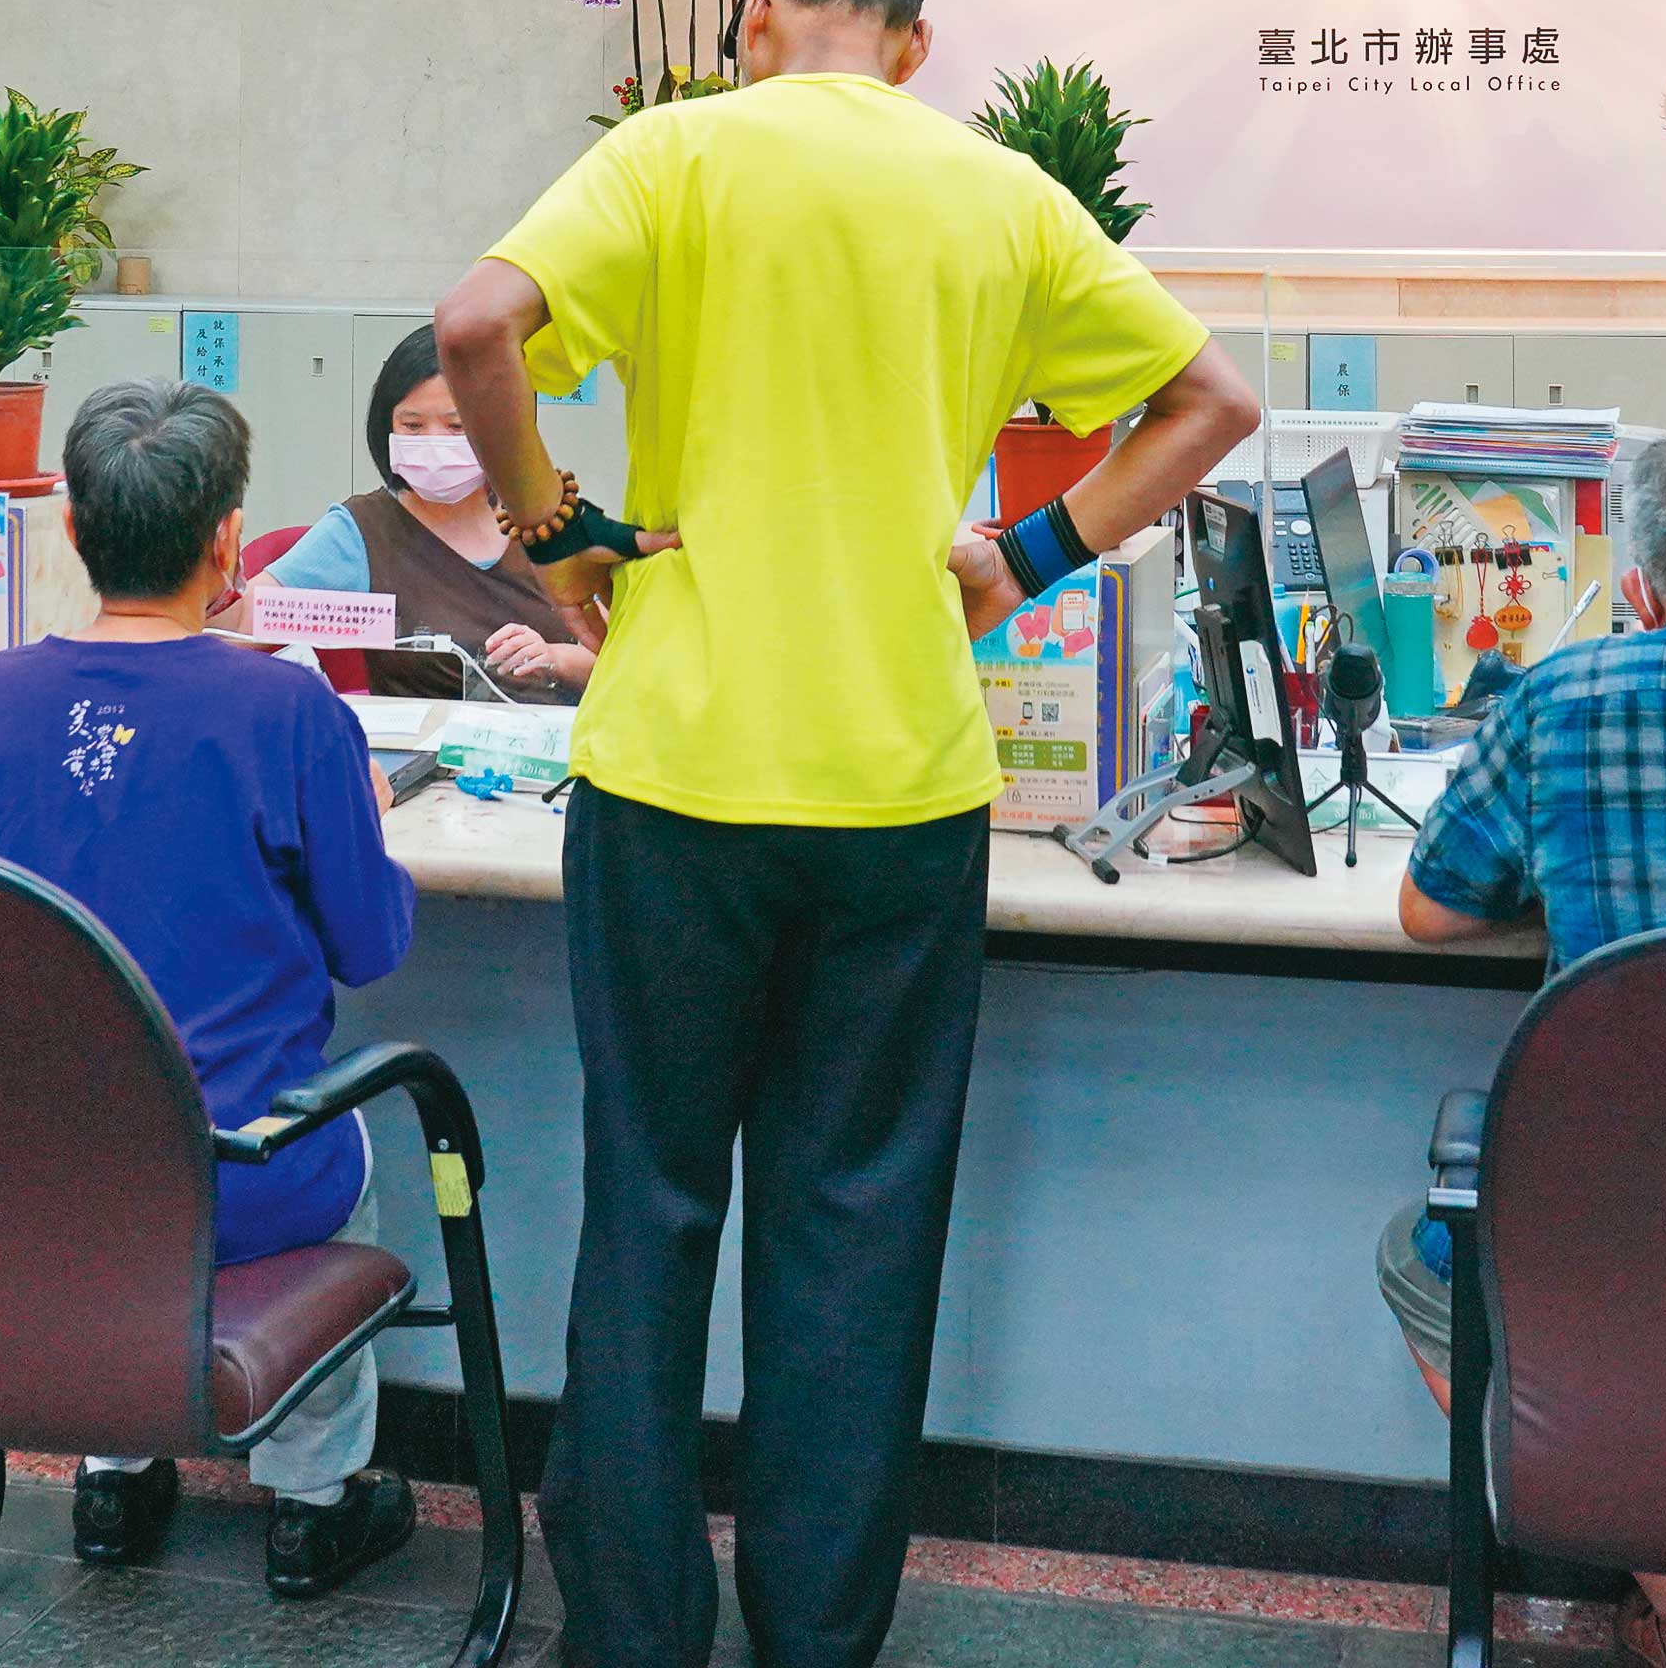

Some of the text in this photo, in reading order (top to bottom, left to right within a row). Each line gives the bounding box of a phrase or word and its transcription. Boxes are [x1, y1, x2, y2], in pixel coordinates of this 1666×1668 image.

[1258, 27, 1559, 65] 臺北市辦事處
[1259, 75, 1561, 95] Taipei City Local Office
